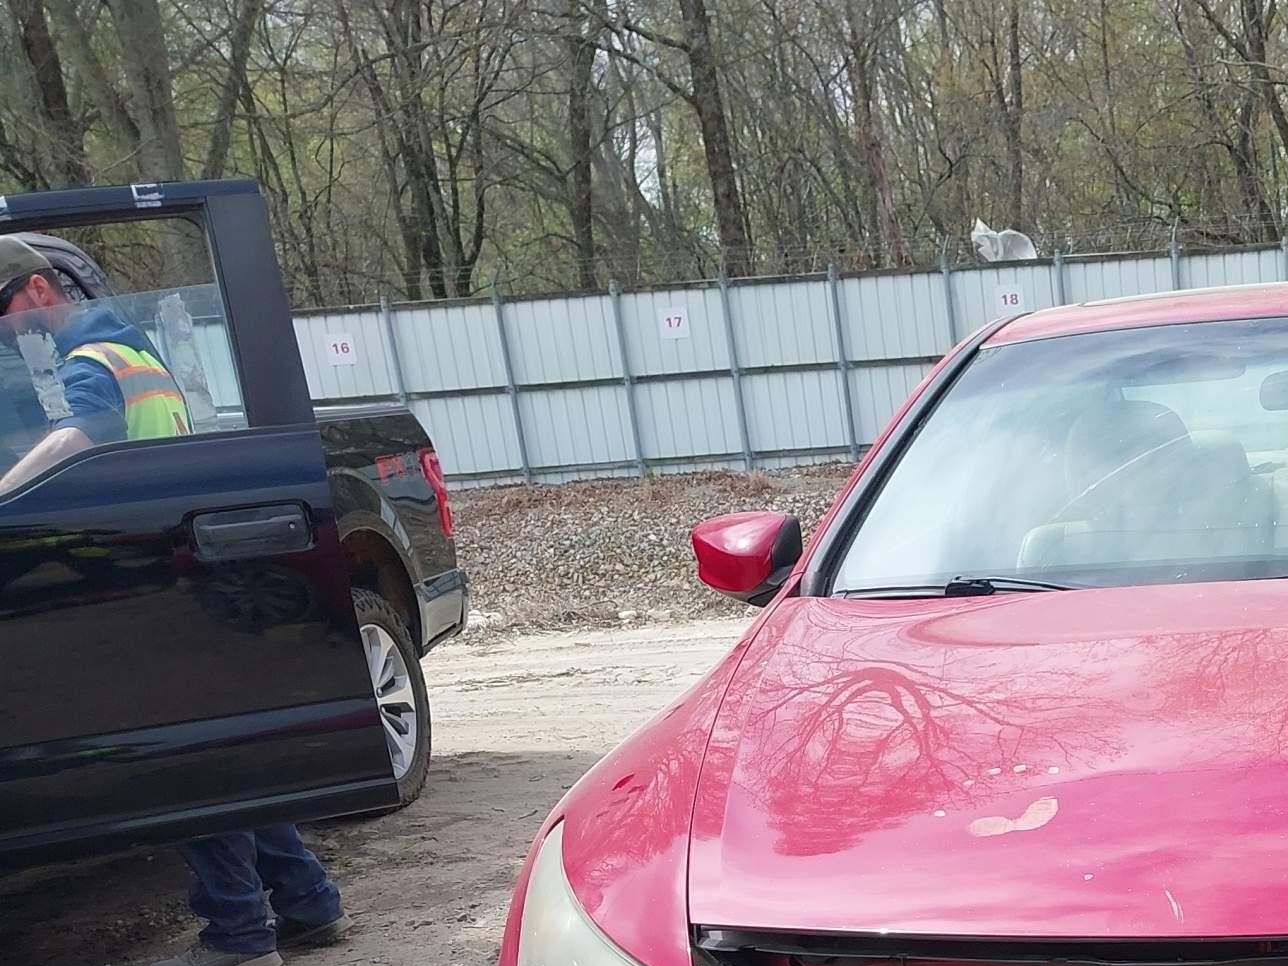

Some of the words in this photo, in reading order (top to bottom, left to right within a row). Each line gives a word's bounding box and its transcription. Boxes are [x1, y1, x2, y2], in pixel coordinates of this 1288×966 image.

[1001, 293, 1019, 305] 18
[665, 316, 682, 328] 17
[332, 342, 350, 355] 16
